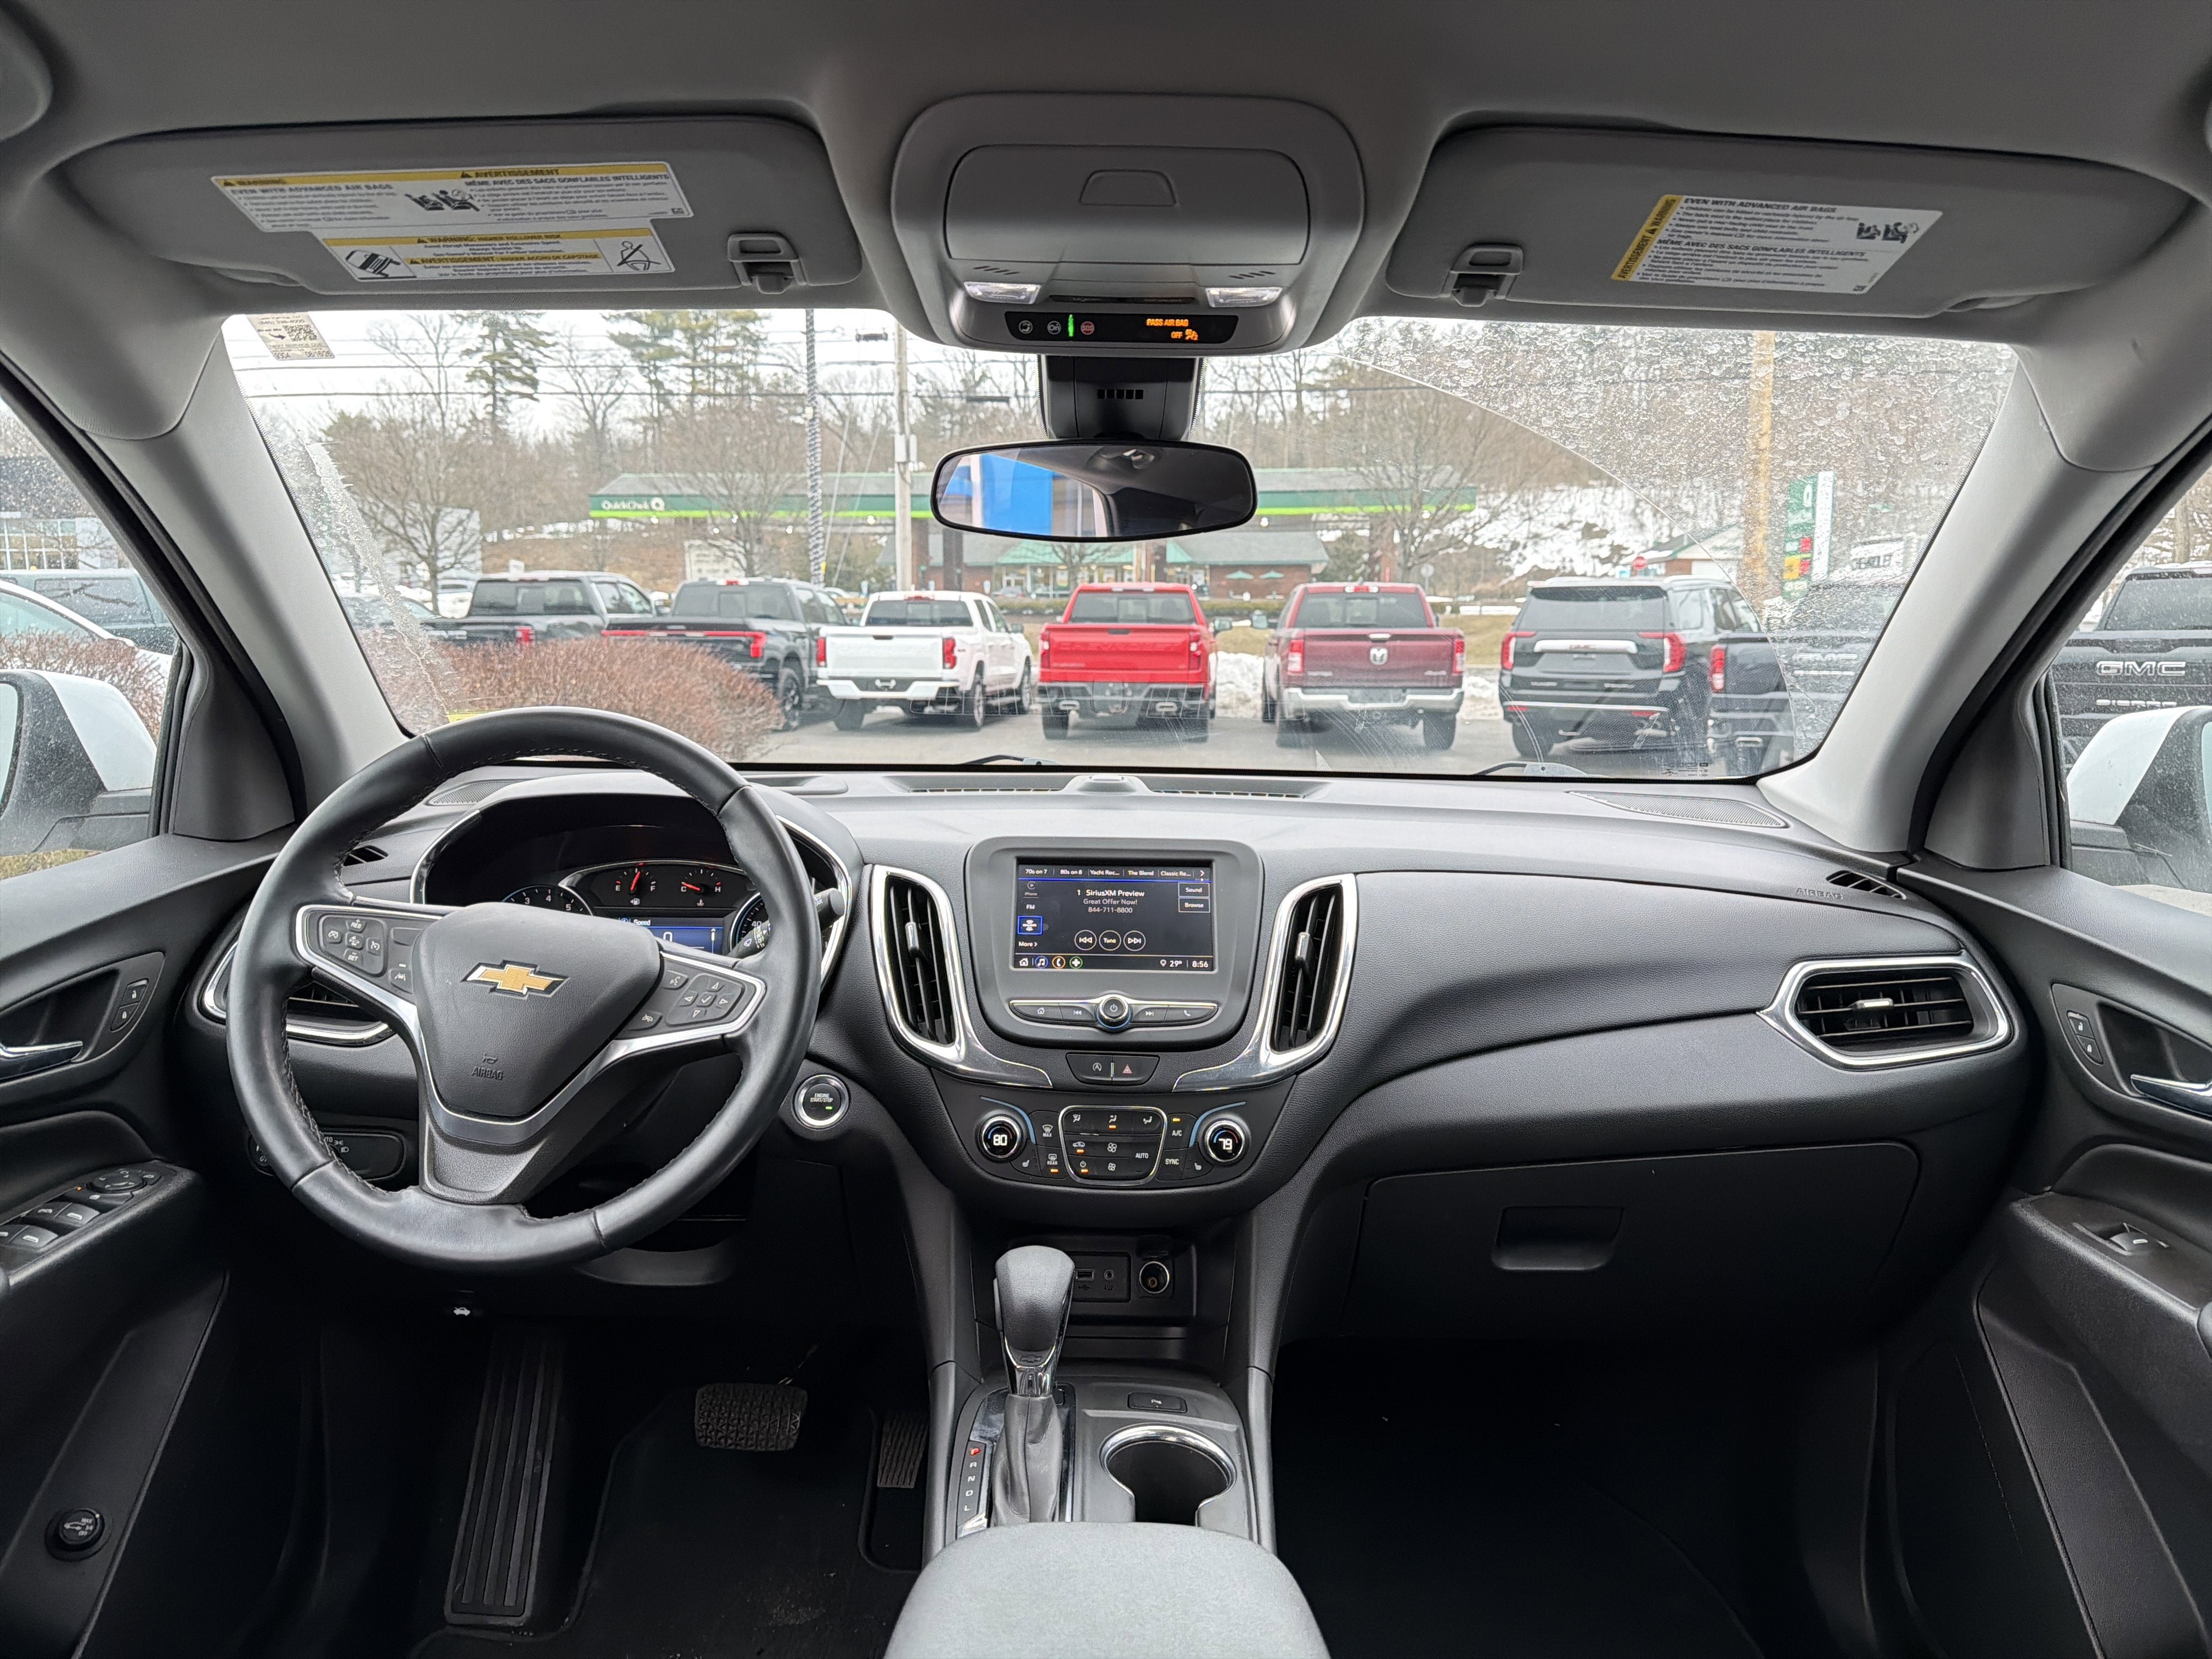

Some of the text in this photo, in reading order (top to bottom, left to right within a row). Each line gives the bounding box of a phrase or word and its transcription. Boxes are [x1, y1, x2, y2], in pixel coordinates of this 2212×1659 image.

[1738, 201, 1790, 210] ADVANCED
[1657, 238, 1684, 246] MÊME
[2096, 661, 2186, 676] GMC
[1796, 887, 1844, 900] AIRBAG
[472, 1066, 504, 1081] AIRBAG
[993, 1135, 1007, 1146] 80
[970, 1448, 981, 1456] P
